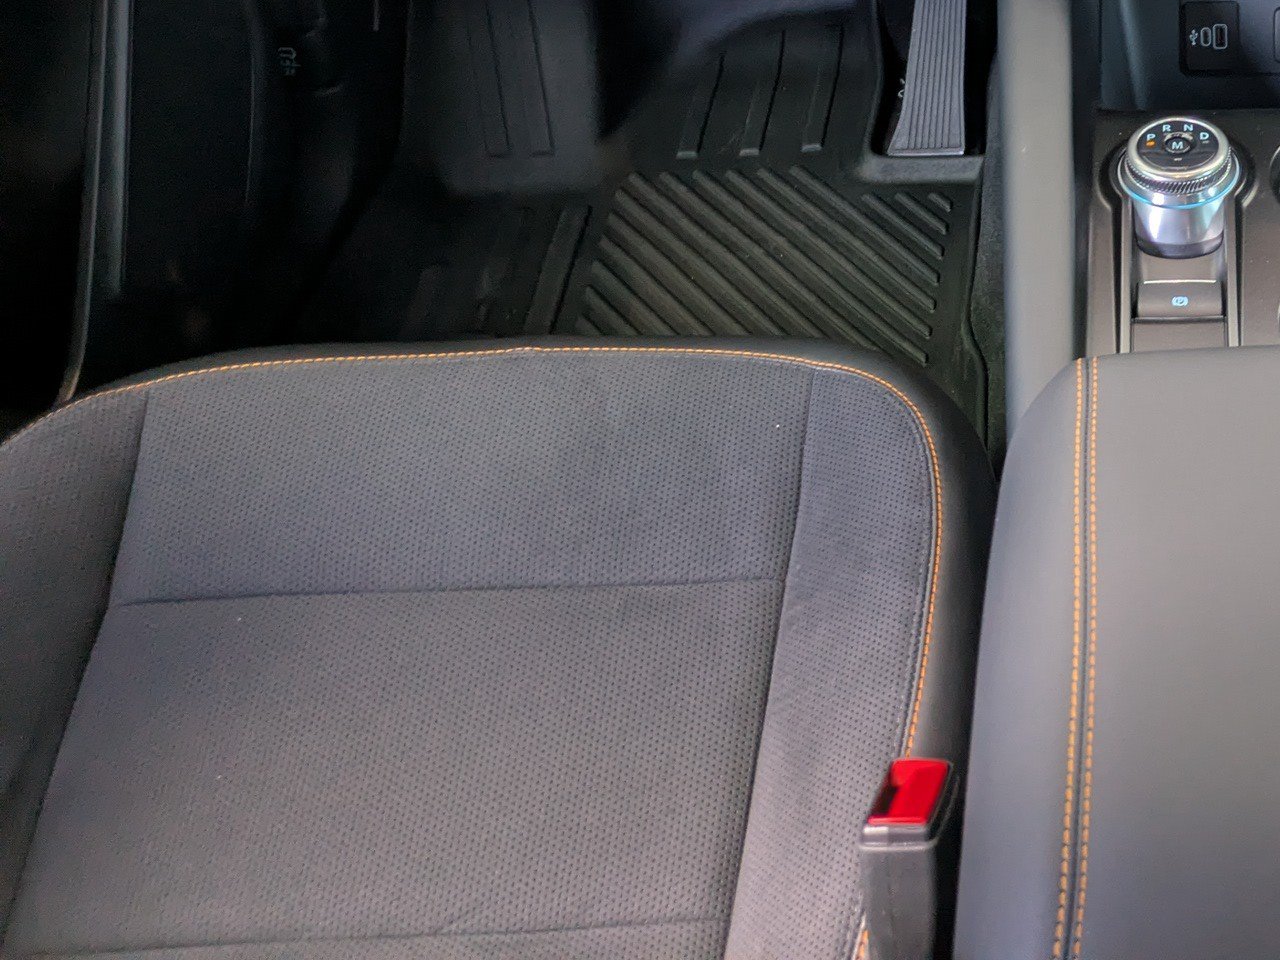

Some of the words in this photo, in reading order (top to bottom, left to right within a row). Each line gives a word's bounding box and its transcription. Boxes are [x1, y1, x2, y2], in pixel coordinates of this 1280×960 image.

[1162, 124, 1171, 132] R
[1183, 124, 1193, 132] N
[1146, 133, 1156, 141] P
[1199, 132, 1210, 140] D
[1171, 141, 1184, 150] M
